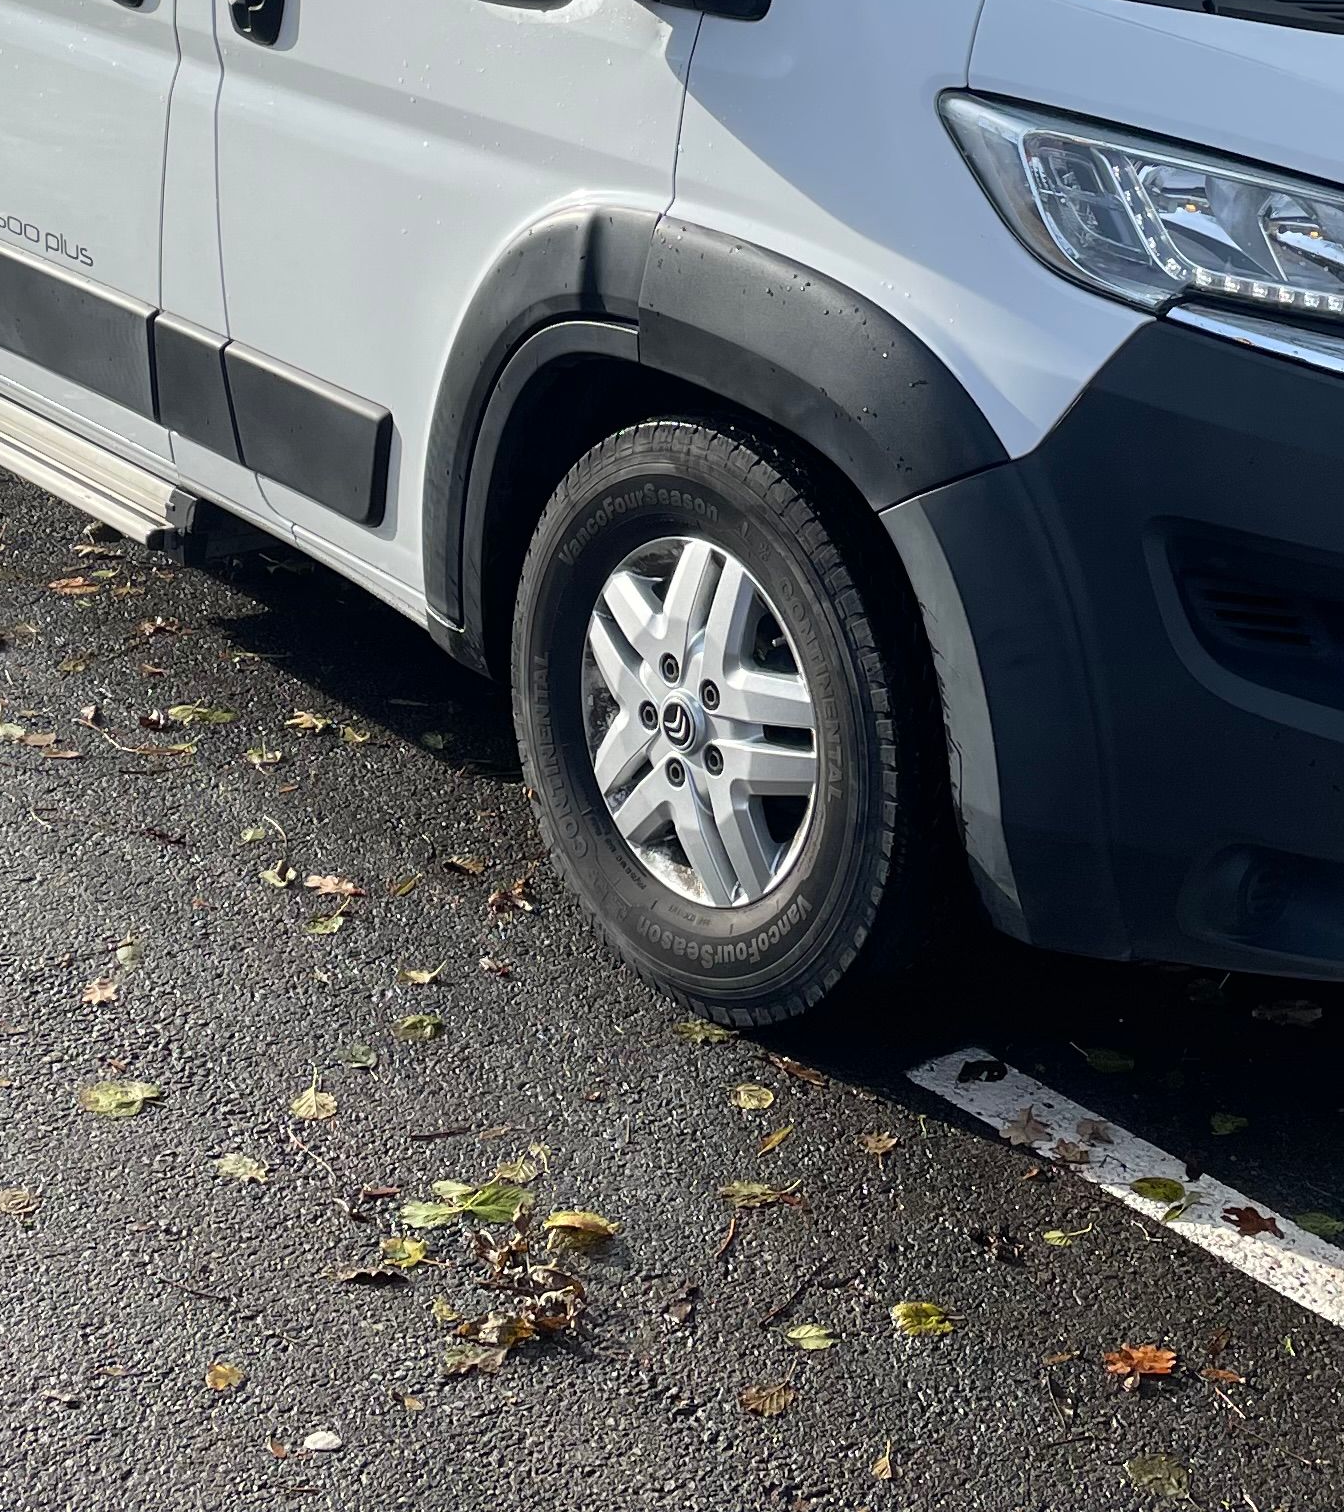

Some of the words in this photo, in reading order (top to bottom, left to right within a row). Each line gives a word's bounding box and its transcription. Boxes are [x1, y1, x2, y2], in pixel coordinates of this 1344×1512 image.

[46, 233, 94, 267] plus
[558, 483, 719, 568] VancoFourSeason
[780, 576, 843, 804] CONTINENTAL
[636, 894, 813, 969] VancoFourSeason
